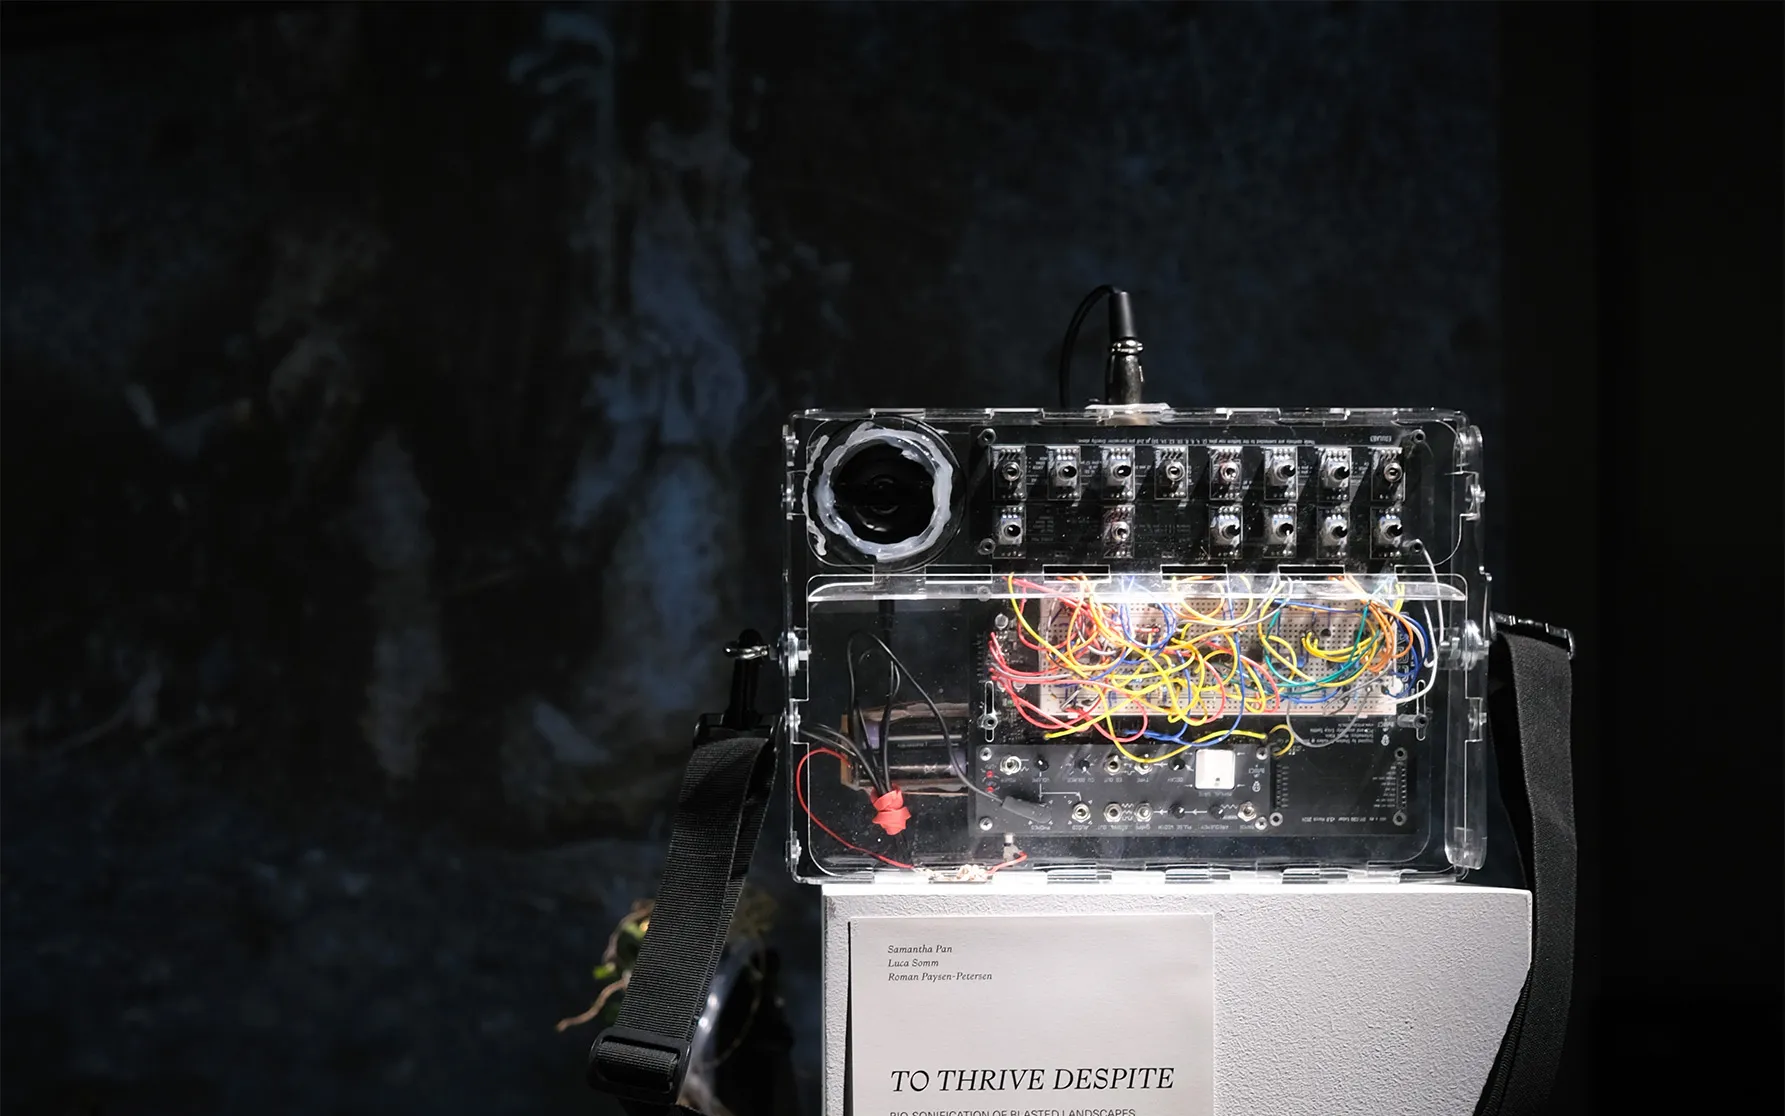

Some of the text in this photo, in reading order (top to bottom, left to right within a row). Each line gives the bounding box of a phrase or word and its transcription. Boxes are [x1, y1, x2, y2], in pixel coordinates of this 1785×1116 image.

[887, 943, 952, 954] Samantha Pan
[887, 957, 939, 967] Luca Somm
[887, 970, 992, 983] Roman Paysen-Petersen
[890, 1066, 1174, 1092] TO THRIVE DESPITE
